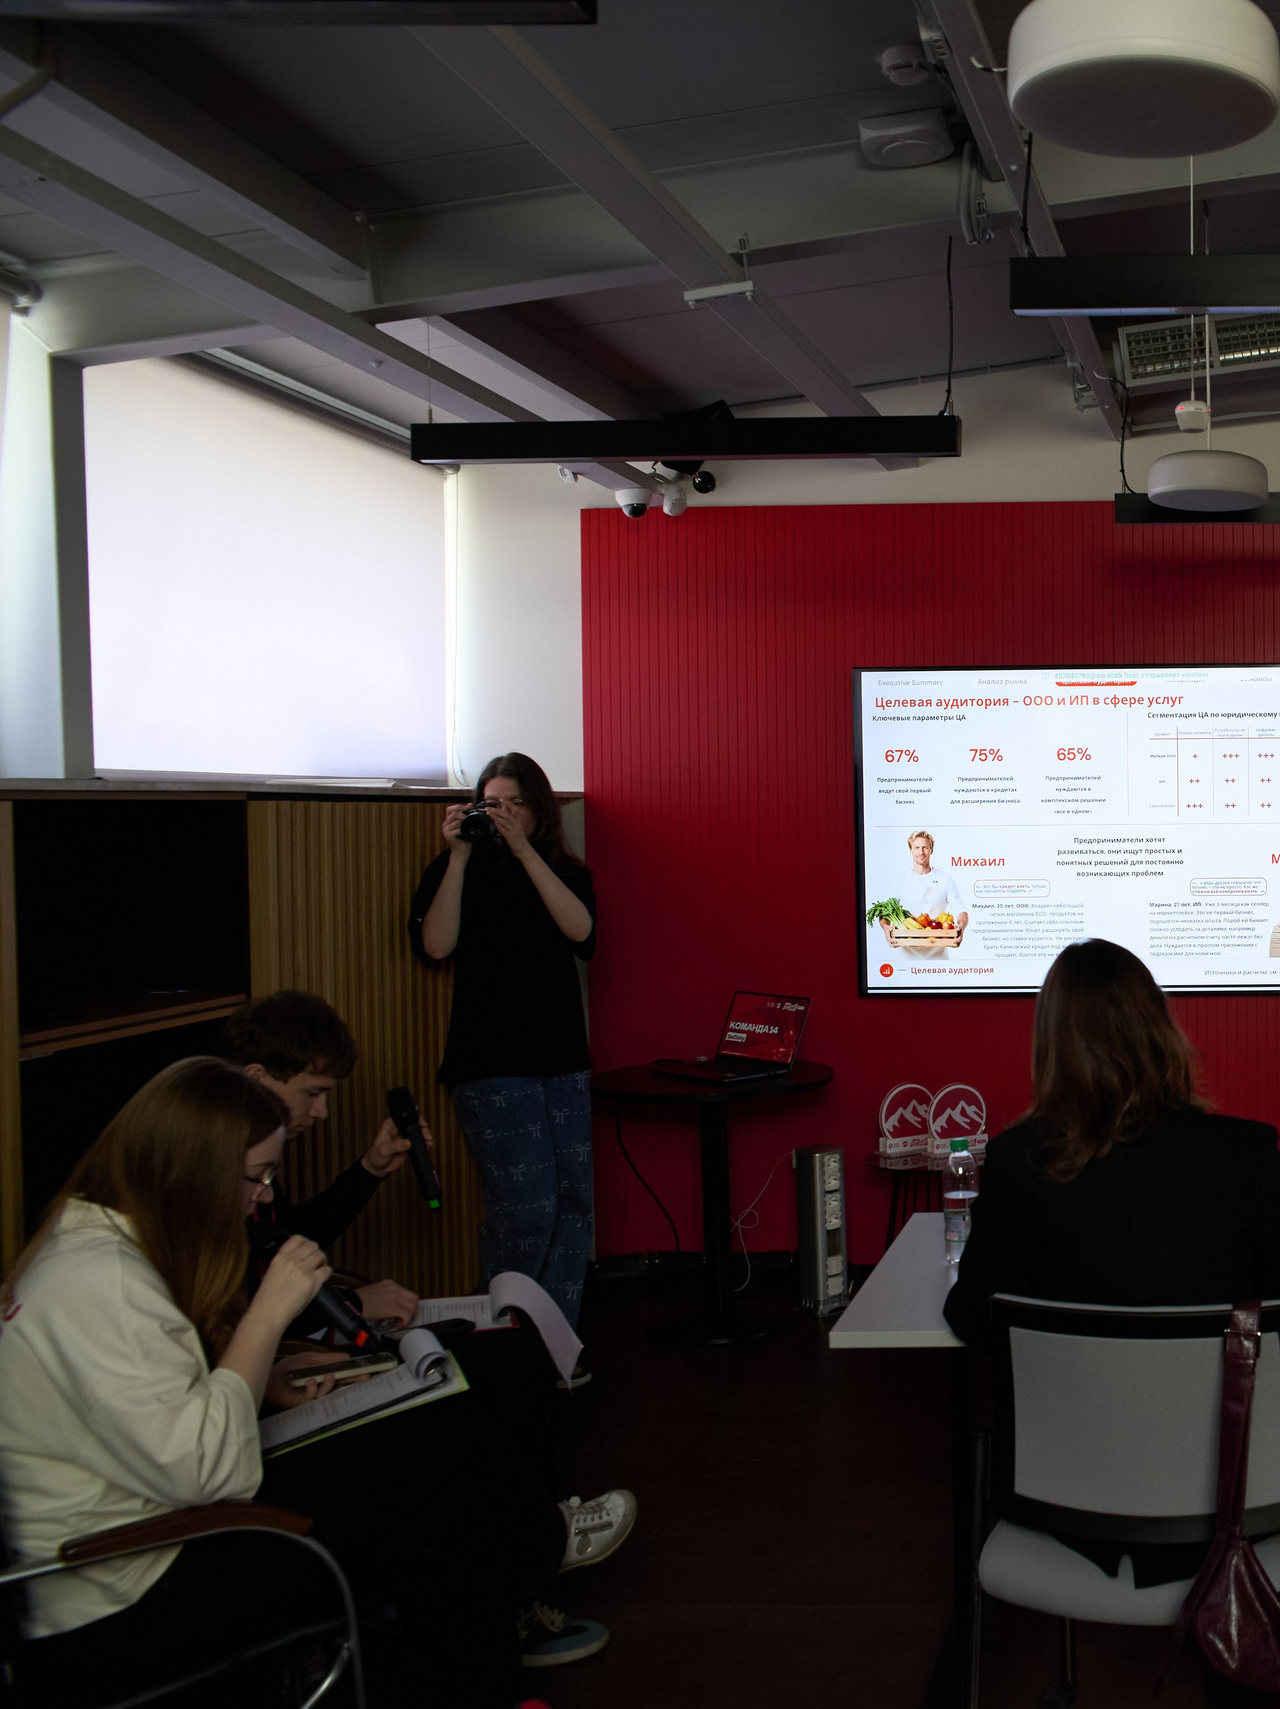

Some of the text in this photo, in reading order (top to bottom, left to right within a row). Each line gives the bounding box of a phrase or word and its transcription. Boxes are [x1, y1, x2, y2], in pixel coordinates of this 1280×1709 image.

[875, 698, 932, 708] Целевая
[935, 698, 1009, 709] аудитория
[1022, 695, 1054, 706] ООО
[1057, 697, 1066, 706] и
[1069, 694, 1089, 706] ИП
[1092, 696, 1100, 706] в
[1103, 696, 1145, 706] сфере
[1147, 696, 1184, 708] услуг
[1198, 711, 1209, 719] ЦА
[884, 749, 919, 763] 67%
[969, 748, 1004, 762] 75%
[1056, 747, 1092, 761] 65%
[951, 857, 1005, 867] Михаил
[910, 967, 947, 975] Целевая
[729, 1021, 779, 1034] КОМАНДА 14
